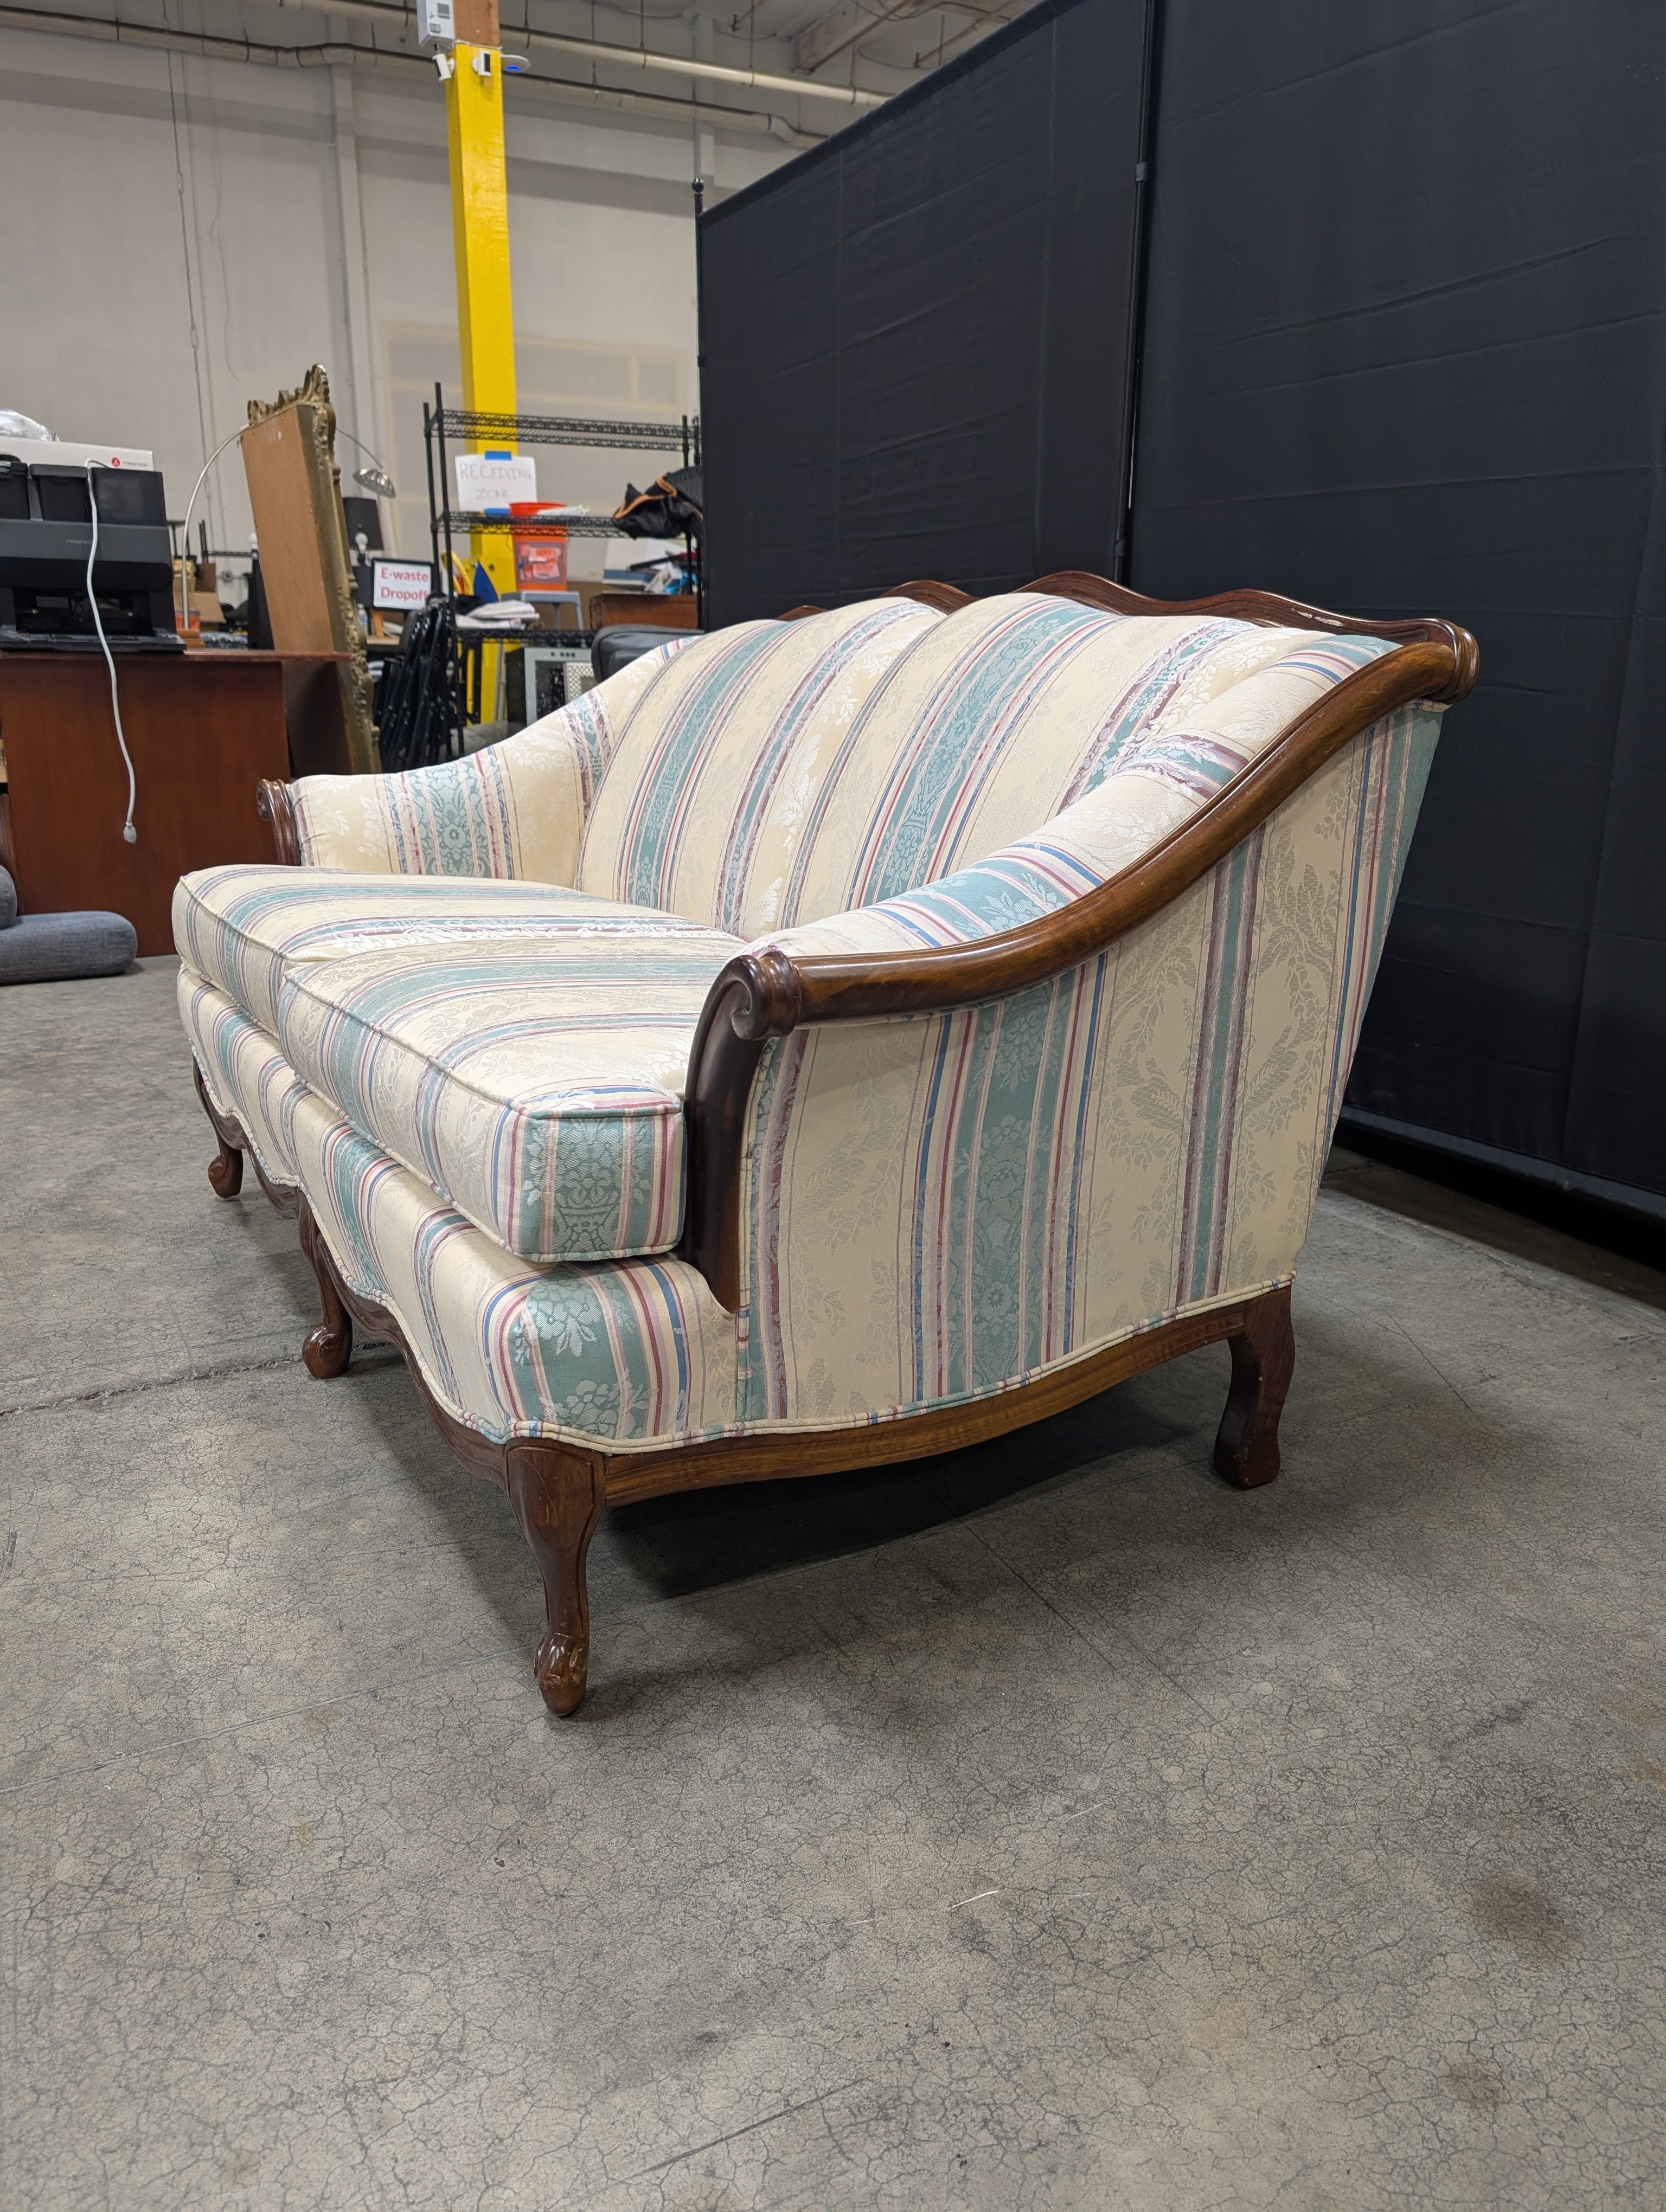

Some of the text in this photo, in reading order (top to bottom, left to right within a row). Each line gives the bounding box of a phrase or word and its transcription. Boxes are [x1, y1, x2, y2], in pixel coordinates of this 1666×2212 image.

[459, 463, 532, 480] RECEIVING
[475, 489, 509, 500] ZONE
[381, 568, 428, 582] E-waste
